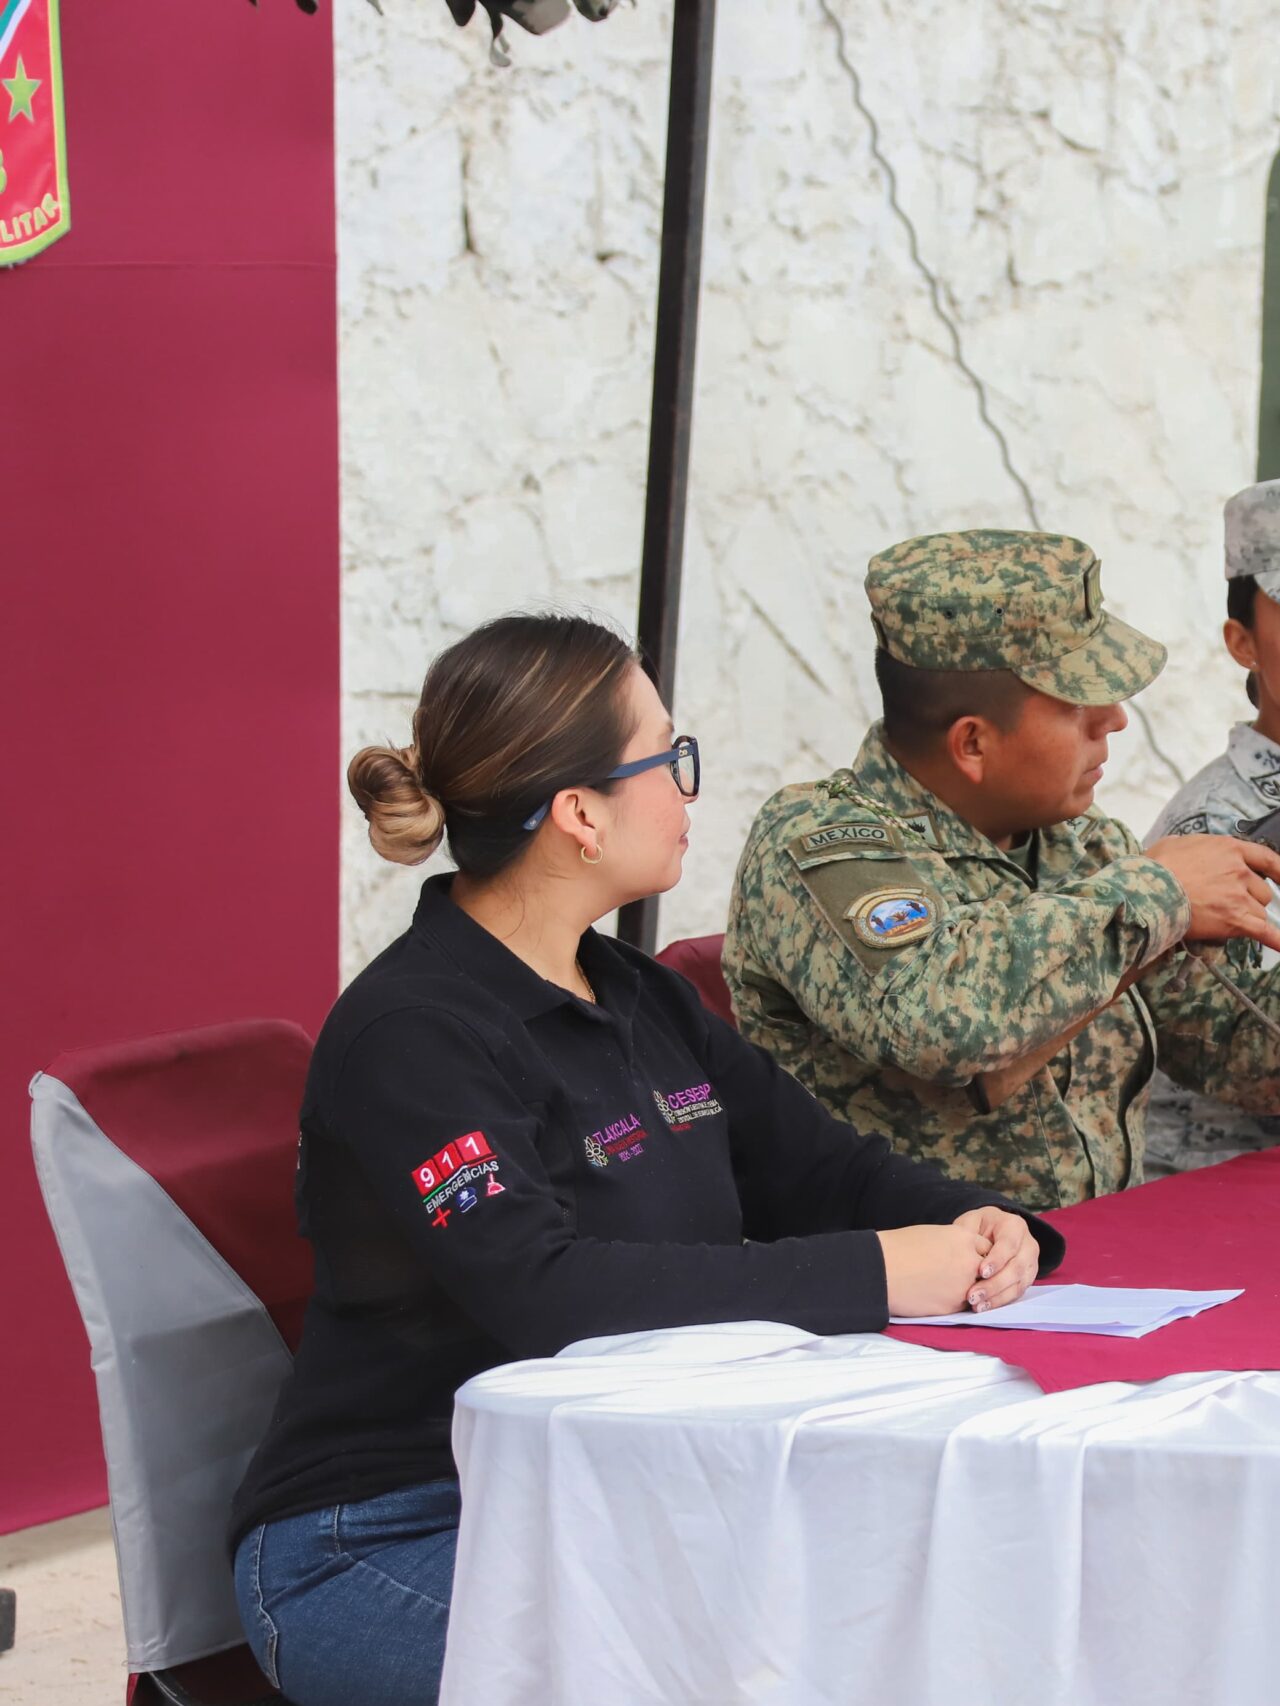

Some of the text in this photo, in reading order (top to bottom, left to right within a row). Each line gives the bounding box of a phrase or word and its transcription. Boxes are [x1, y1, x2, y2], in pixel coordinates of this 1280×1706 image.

[810, 827, 884, 846] MEXICO
[668, 1083, 711, 1109] CESESP
[592, 1113, 641, 1146] TLAXCALA
[426, 1160, 500, 1214] EMERGENCIAS
